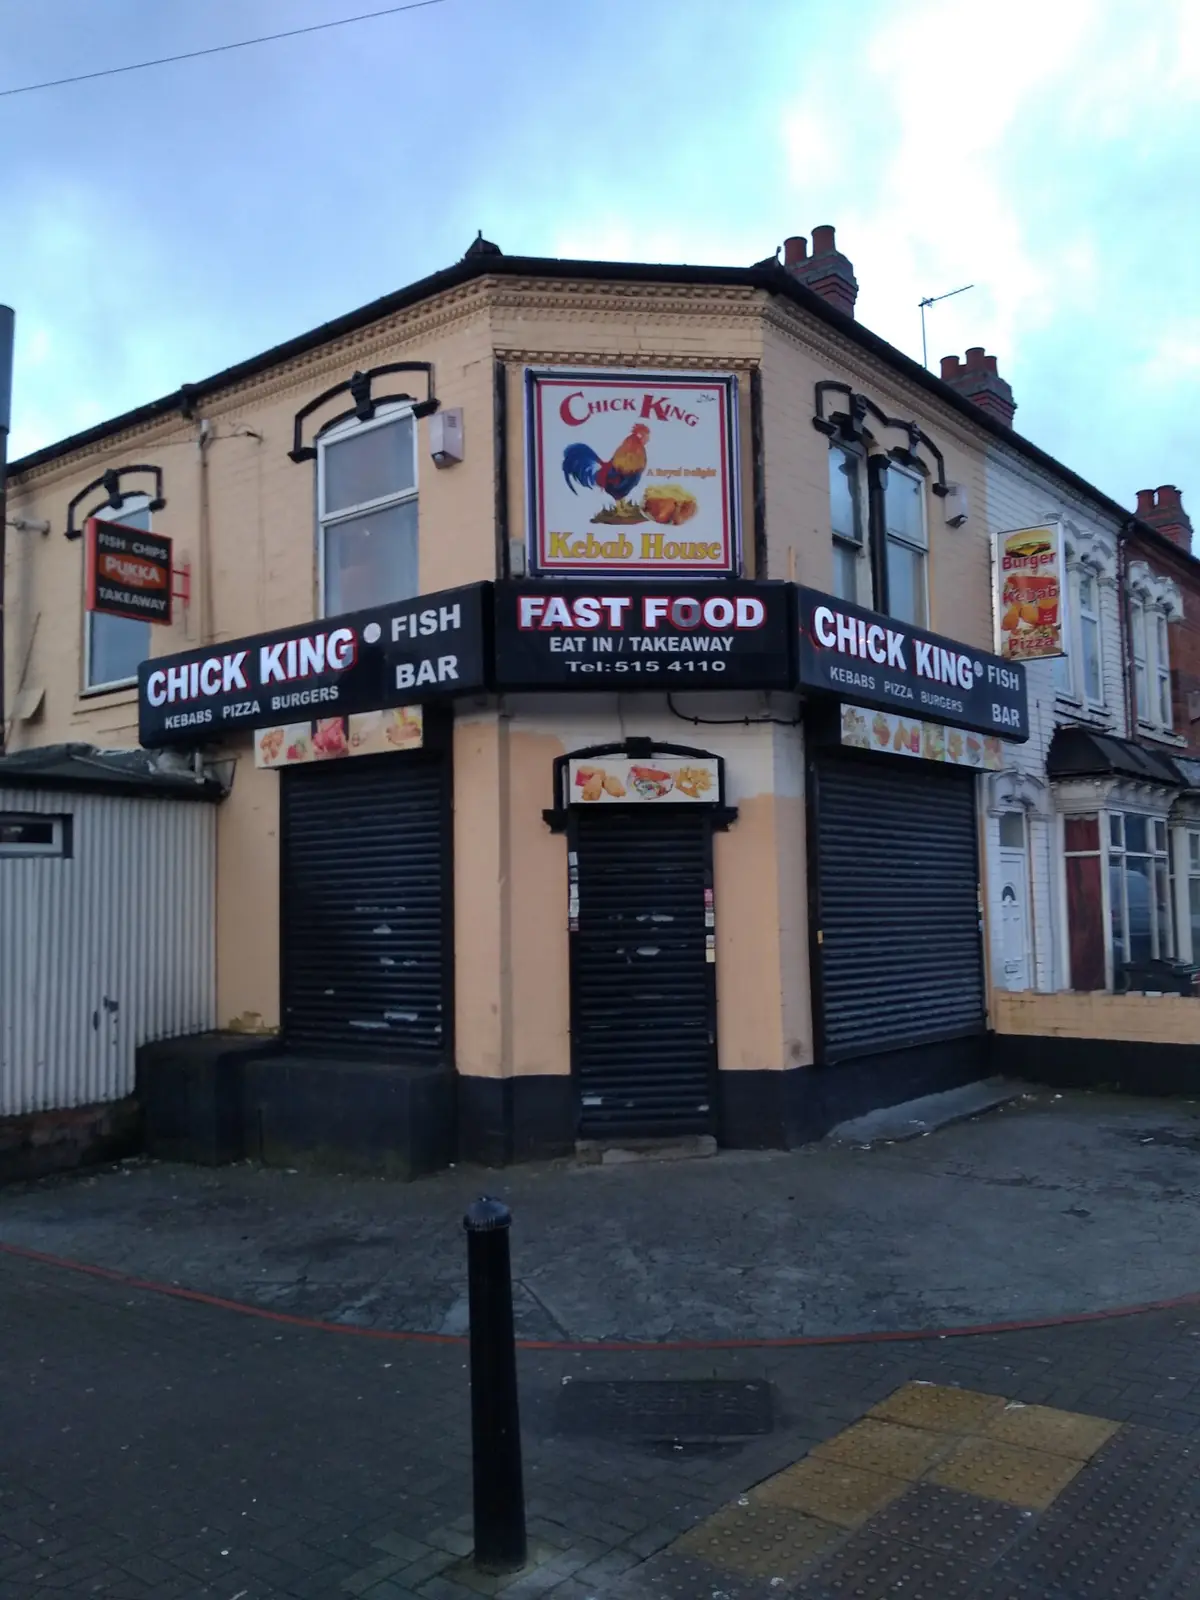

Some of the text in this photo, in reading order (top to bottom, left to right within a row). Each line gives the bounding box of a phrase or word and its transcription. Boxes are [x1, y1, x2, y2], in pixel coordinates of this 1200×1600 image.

[560, 391, 700, 427] CHICK KING
[98, 533, 168, 560] FISH CHIPS
[548, 532, 721, 560] Kebab House
[105, 555, 161, 583] PUKKA
[1002, 552, 1057, 571] Burger
[98, 587, 168, 611] TAKEAWAY
[1003, 584, 1058, 605] Kebab
[517, 595, 766, 631] FAST FOOD
[147, 603, 461, 707] CHICK KING FISH
[549, 636, 587, 652] EAT
[592, 636, 613, 652] IN
[629, 636, 734, 652] TAKEAWAY
[812, 605, 1019, 691] CHICK KING FISH
[1008, 636, 1055, 651] Pizza
[395, 655, 459, 689] BAR
[667, 660, 726, 672] 4110
[830, 666, 964, 713] KEBABS PIZZA BURGERS
[164, 685, 339, 730] KEBABS PIZZA BURGERS
[992, 703, 1020, 728] BAR
